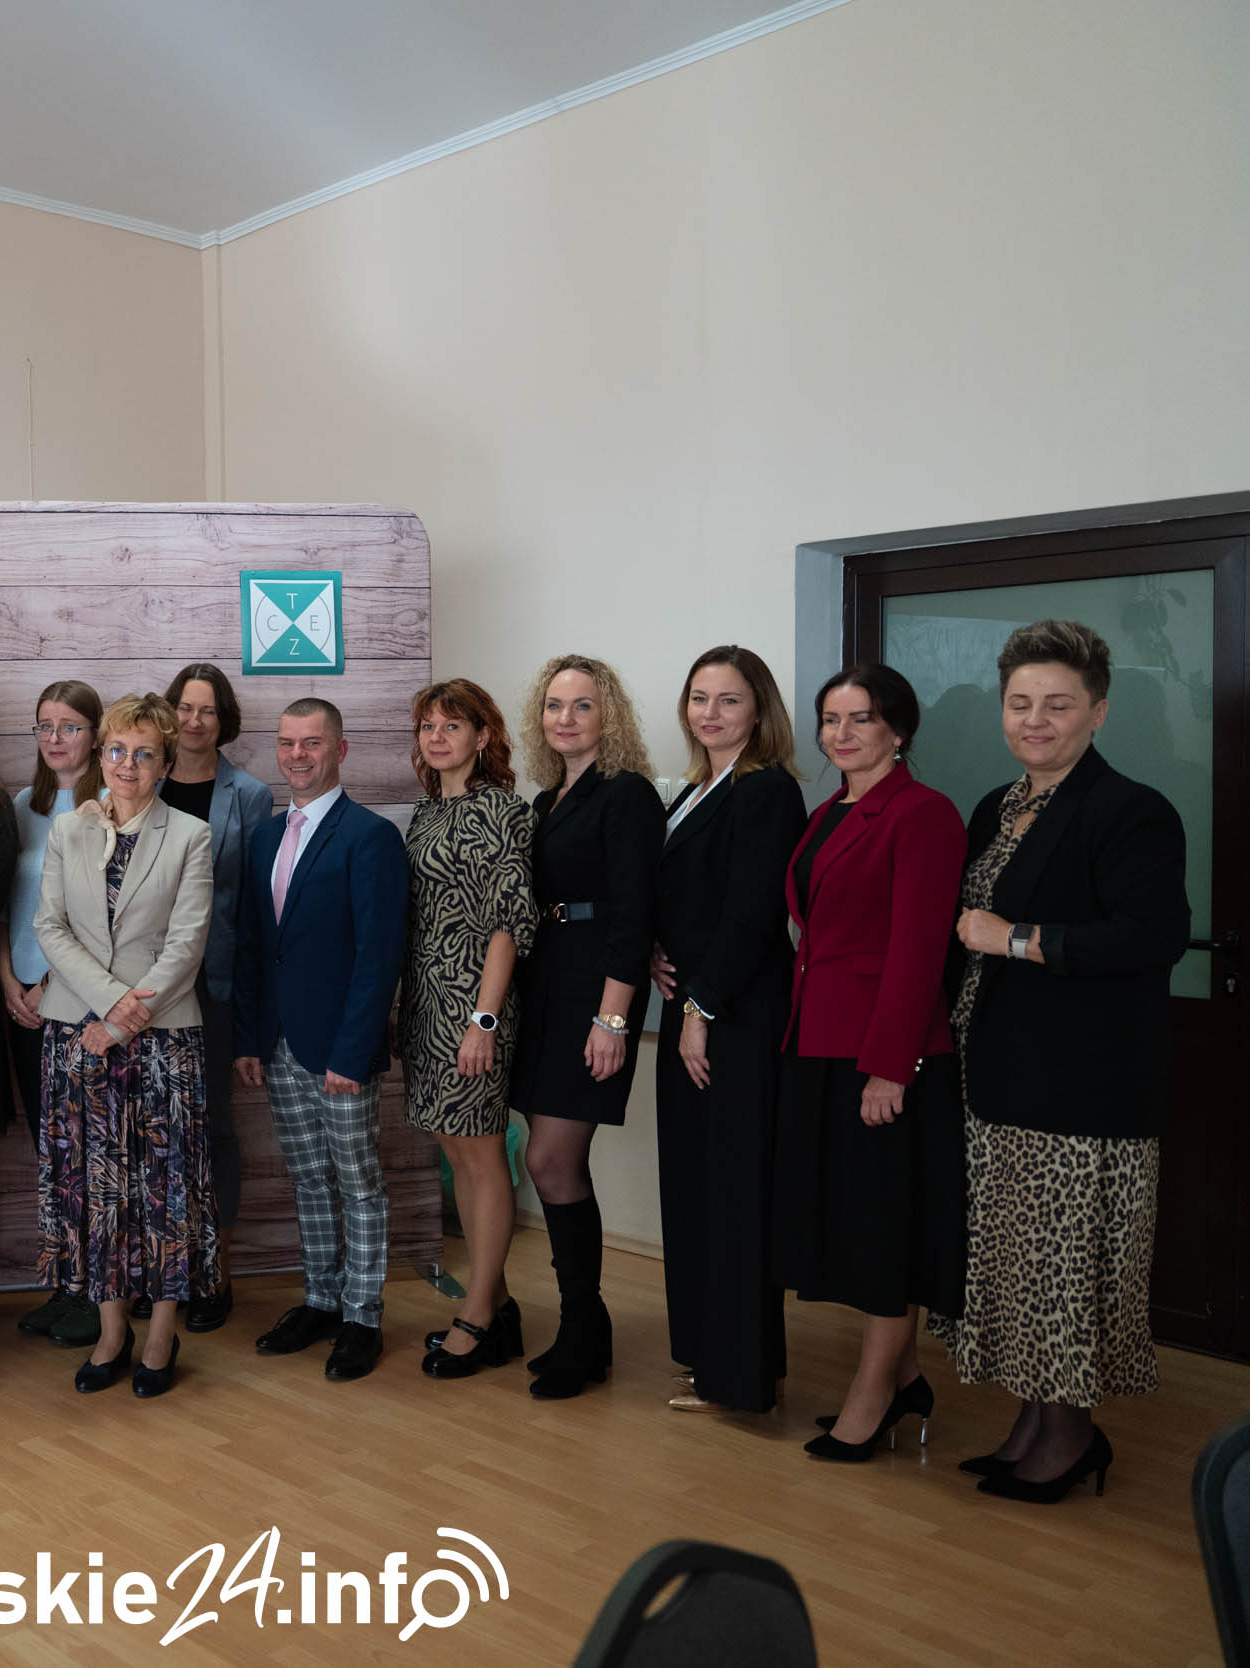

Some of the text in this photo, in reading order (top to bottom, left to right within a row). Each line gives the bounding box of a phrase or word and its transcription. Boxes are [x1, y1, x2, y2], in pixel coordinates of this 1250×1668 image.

[286, 593, 299, 609] T
[267, 615, 320, 631] C E
[289, 638, 300, 655] Z
